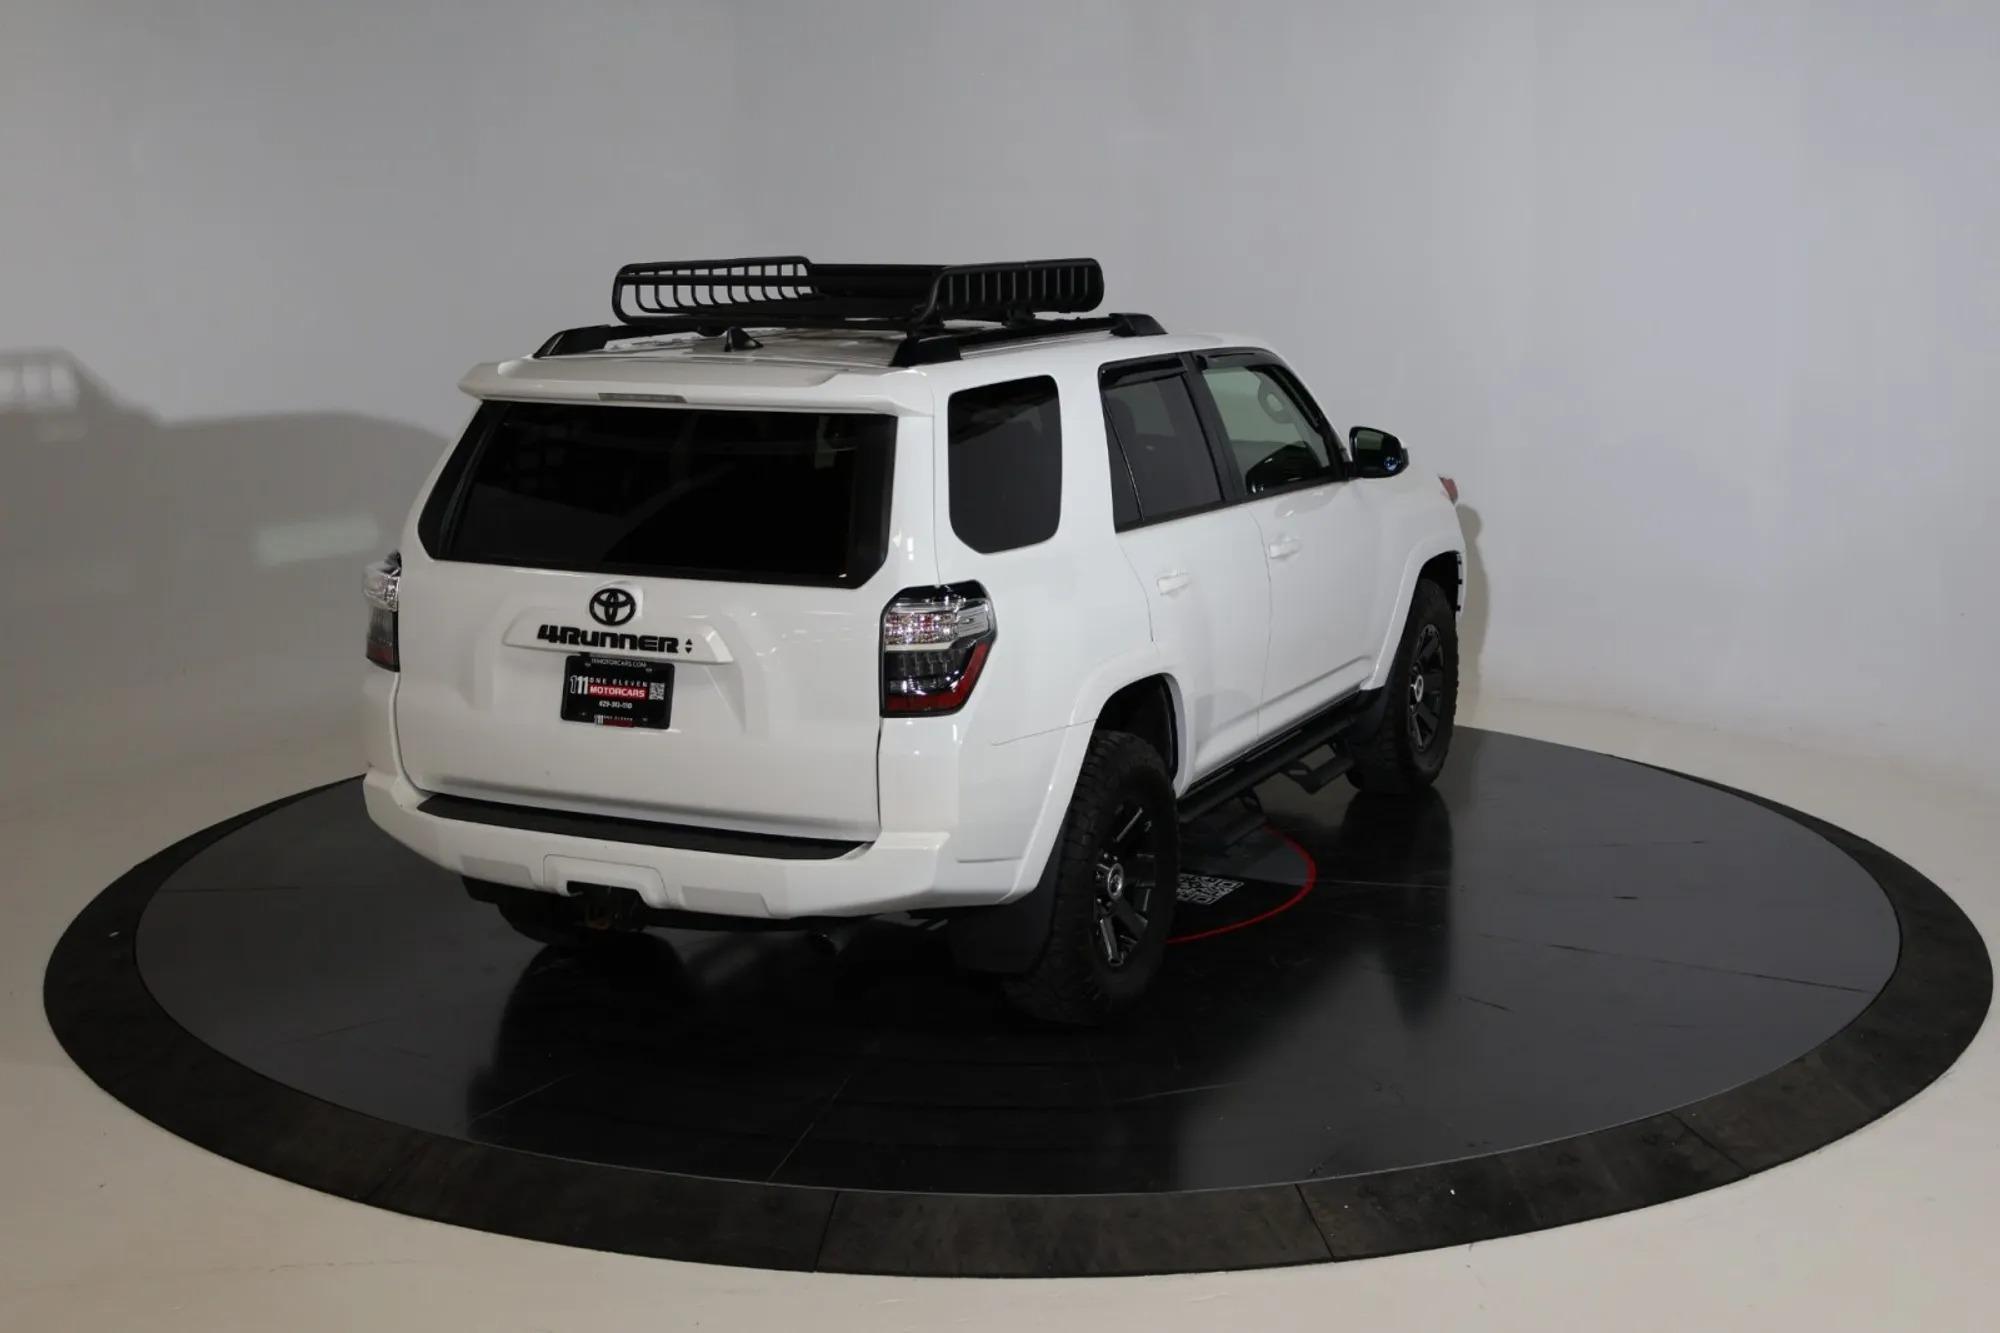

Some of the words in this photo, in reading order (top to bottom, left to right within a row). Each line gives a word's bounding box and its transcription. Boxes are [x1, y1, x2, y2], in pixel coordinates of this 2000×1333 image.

[589, 677, 607, 686] ONE
[612, 678, 648, 687] ELEVEN
[590, 686, 646, 698] MOTORCARS
